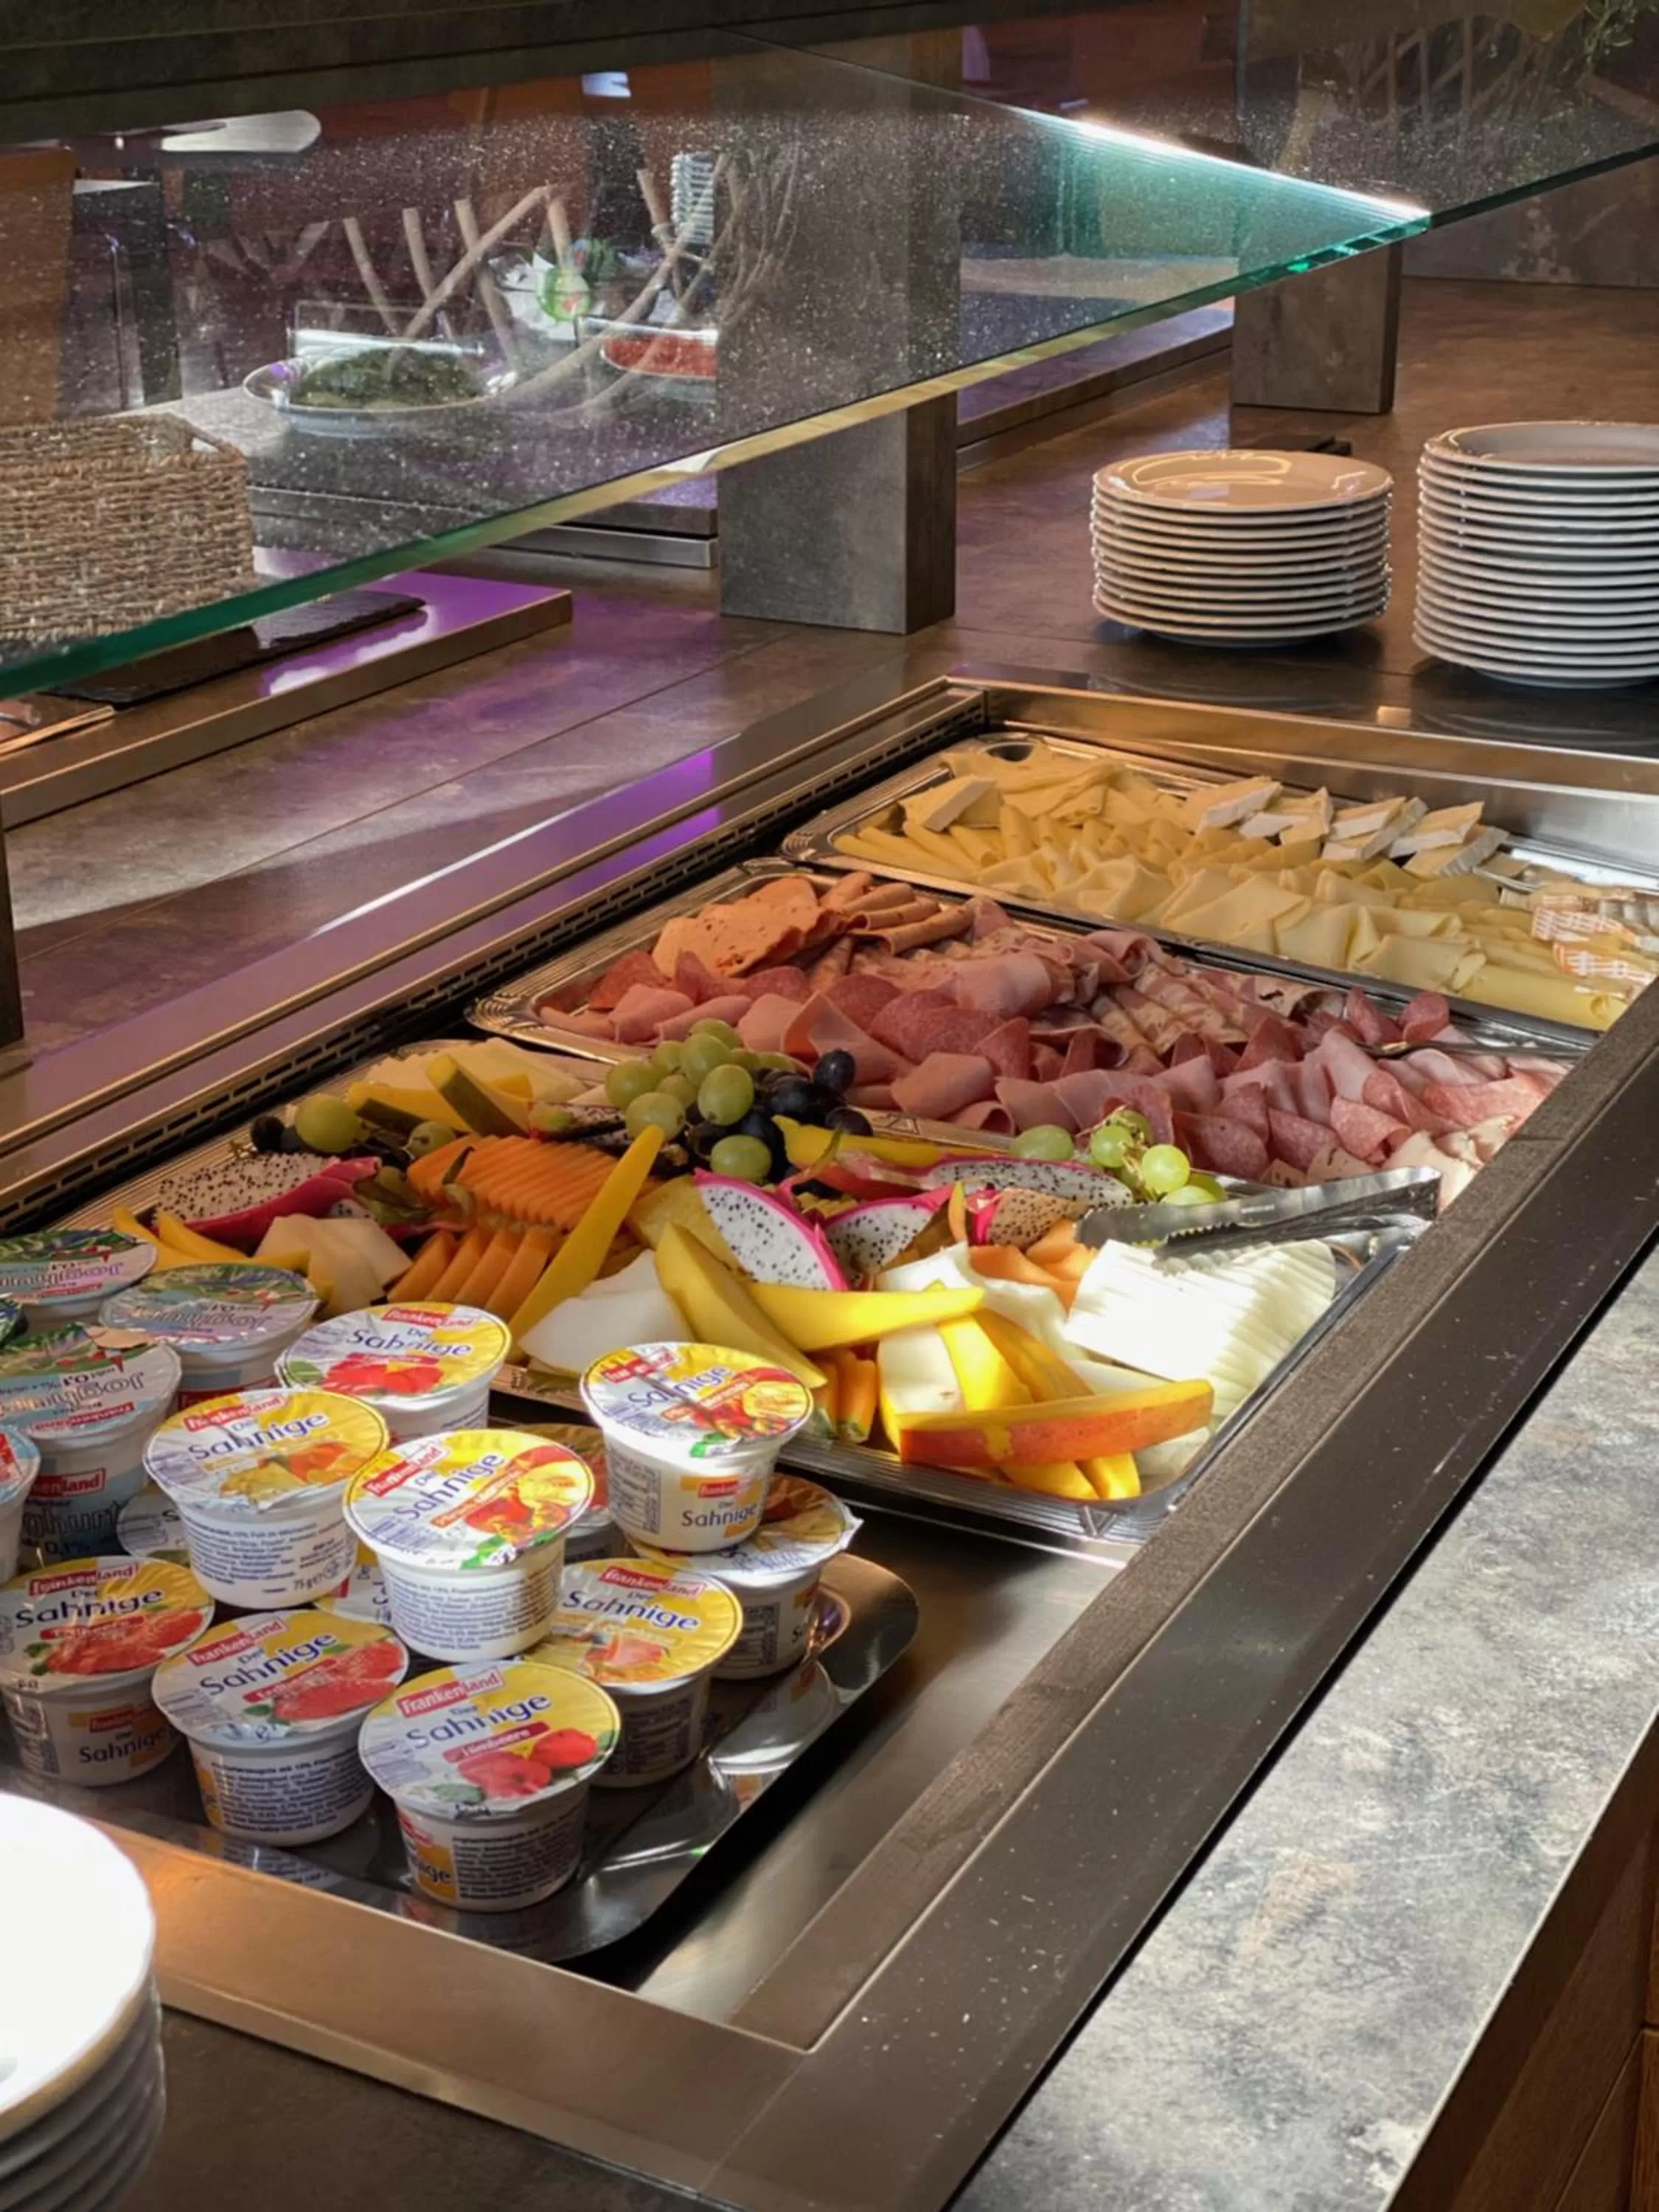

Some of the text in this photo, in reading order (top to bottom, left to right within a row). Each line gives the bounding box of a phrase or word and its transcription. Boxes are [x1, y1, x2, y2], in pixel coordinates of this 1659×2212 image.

[188, 1414, 327, 1460] Sahnige
[394, 1453, 501, 1520] Sahnige
[681, 1503, 757, 1527] Sahnige
[15, 1590, 163, 1629] Sahnige
[563, 1590, 699, 1630] Sahnige
[191, 1621, 282, 1666] Frankenland
[200, 1632, 337, 1695] Sahnige
[238, 1647, 264, 1664] Der
[402, 1671, 502, 1717] Frankenland
[406, 1694, 552, 1749] Sahnige
